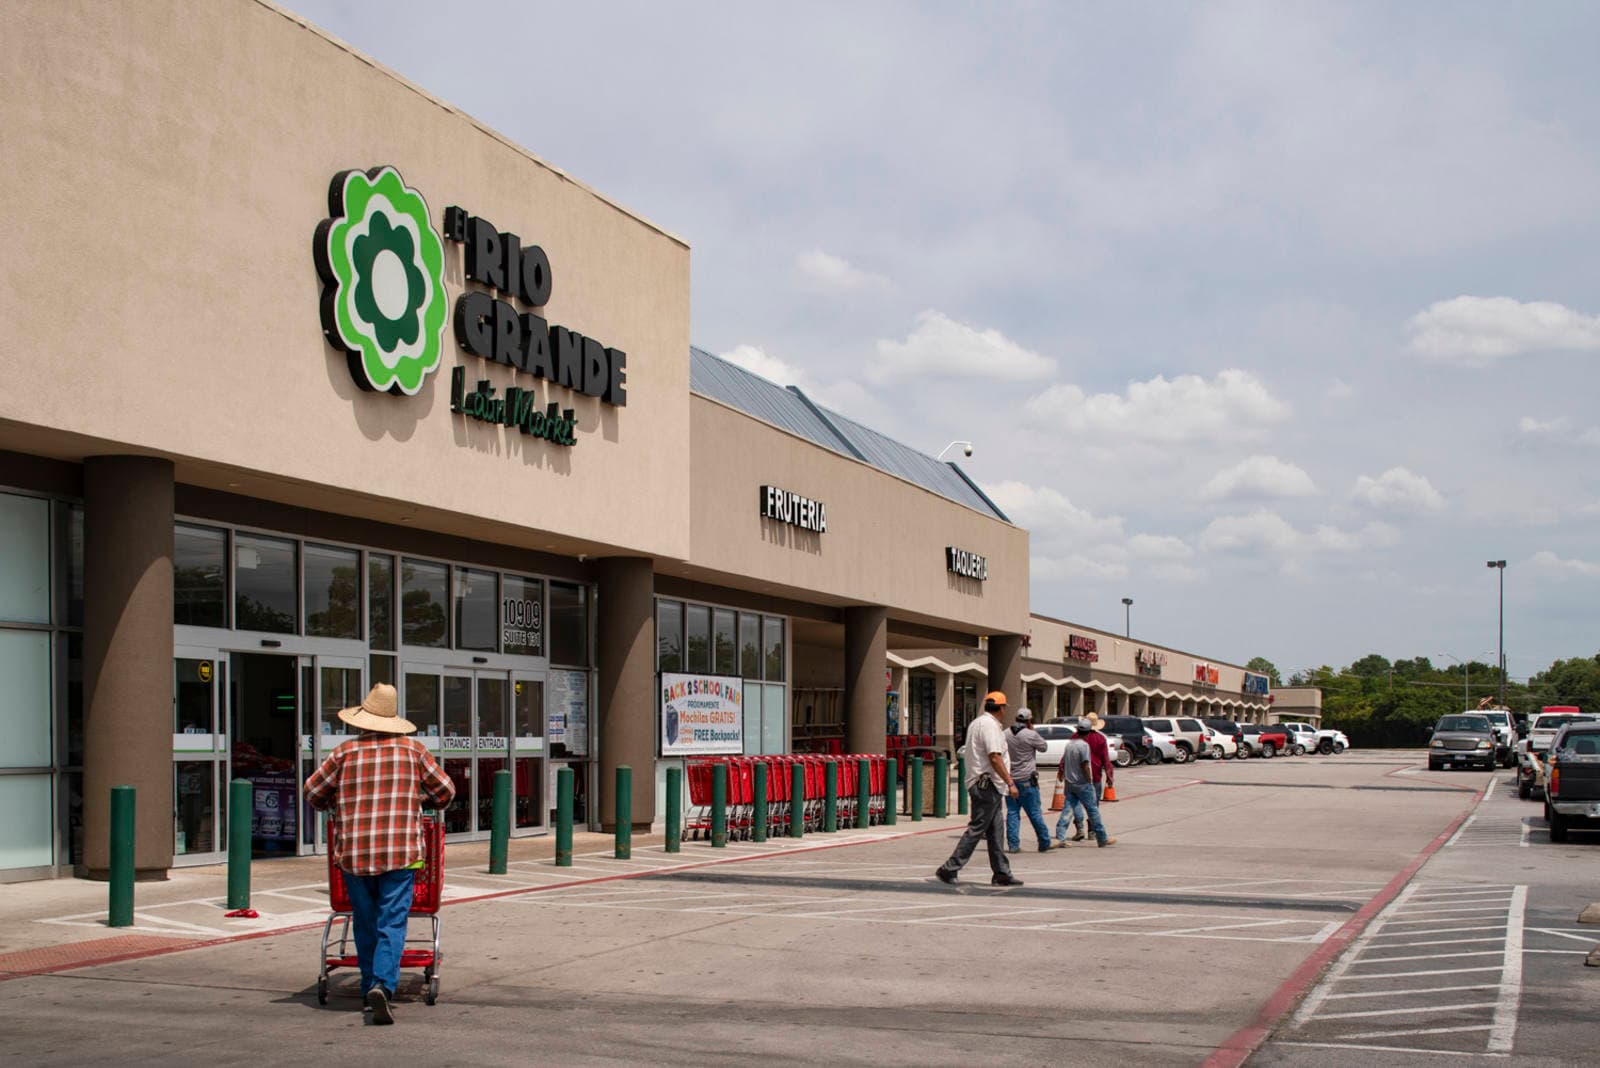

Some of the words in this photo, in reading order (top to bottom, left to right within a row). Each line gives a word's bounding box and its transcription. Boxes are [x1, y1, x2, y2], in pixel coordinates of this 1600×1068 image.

[468, 214, 551, 307] RIO
[455, 291, 626, 407] GRANDE
[452, 365, 506, 427] Latin
[506, 387, 578, 447] Market
[762, 485, 828, 534] FRUTERIA
[948, 547, 989, 581] TAQUERIA
[503, 598, 541, 629] 10909
[503, 629, 527, 646] SUITE
[664, 681, 686, 703] BACK
[688, 682, 692, 695] 2
[693, 680, 723, 697] SCHOOL
[726, 686, 740, 704] FAIR
[479, 738, 504, 749] ENTRADA
[694, 729, 709, 741] FREE
